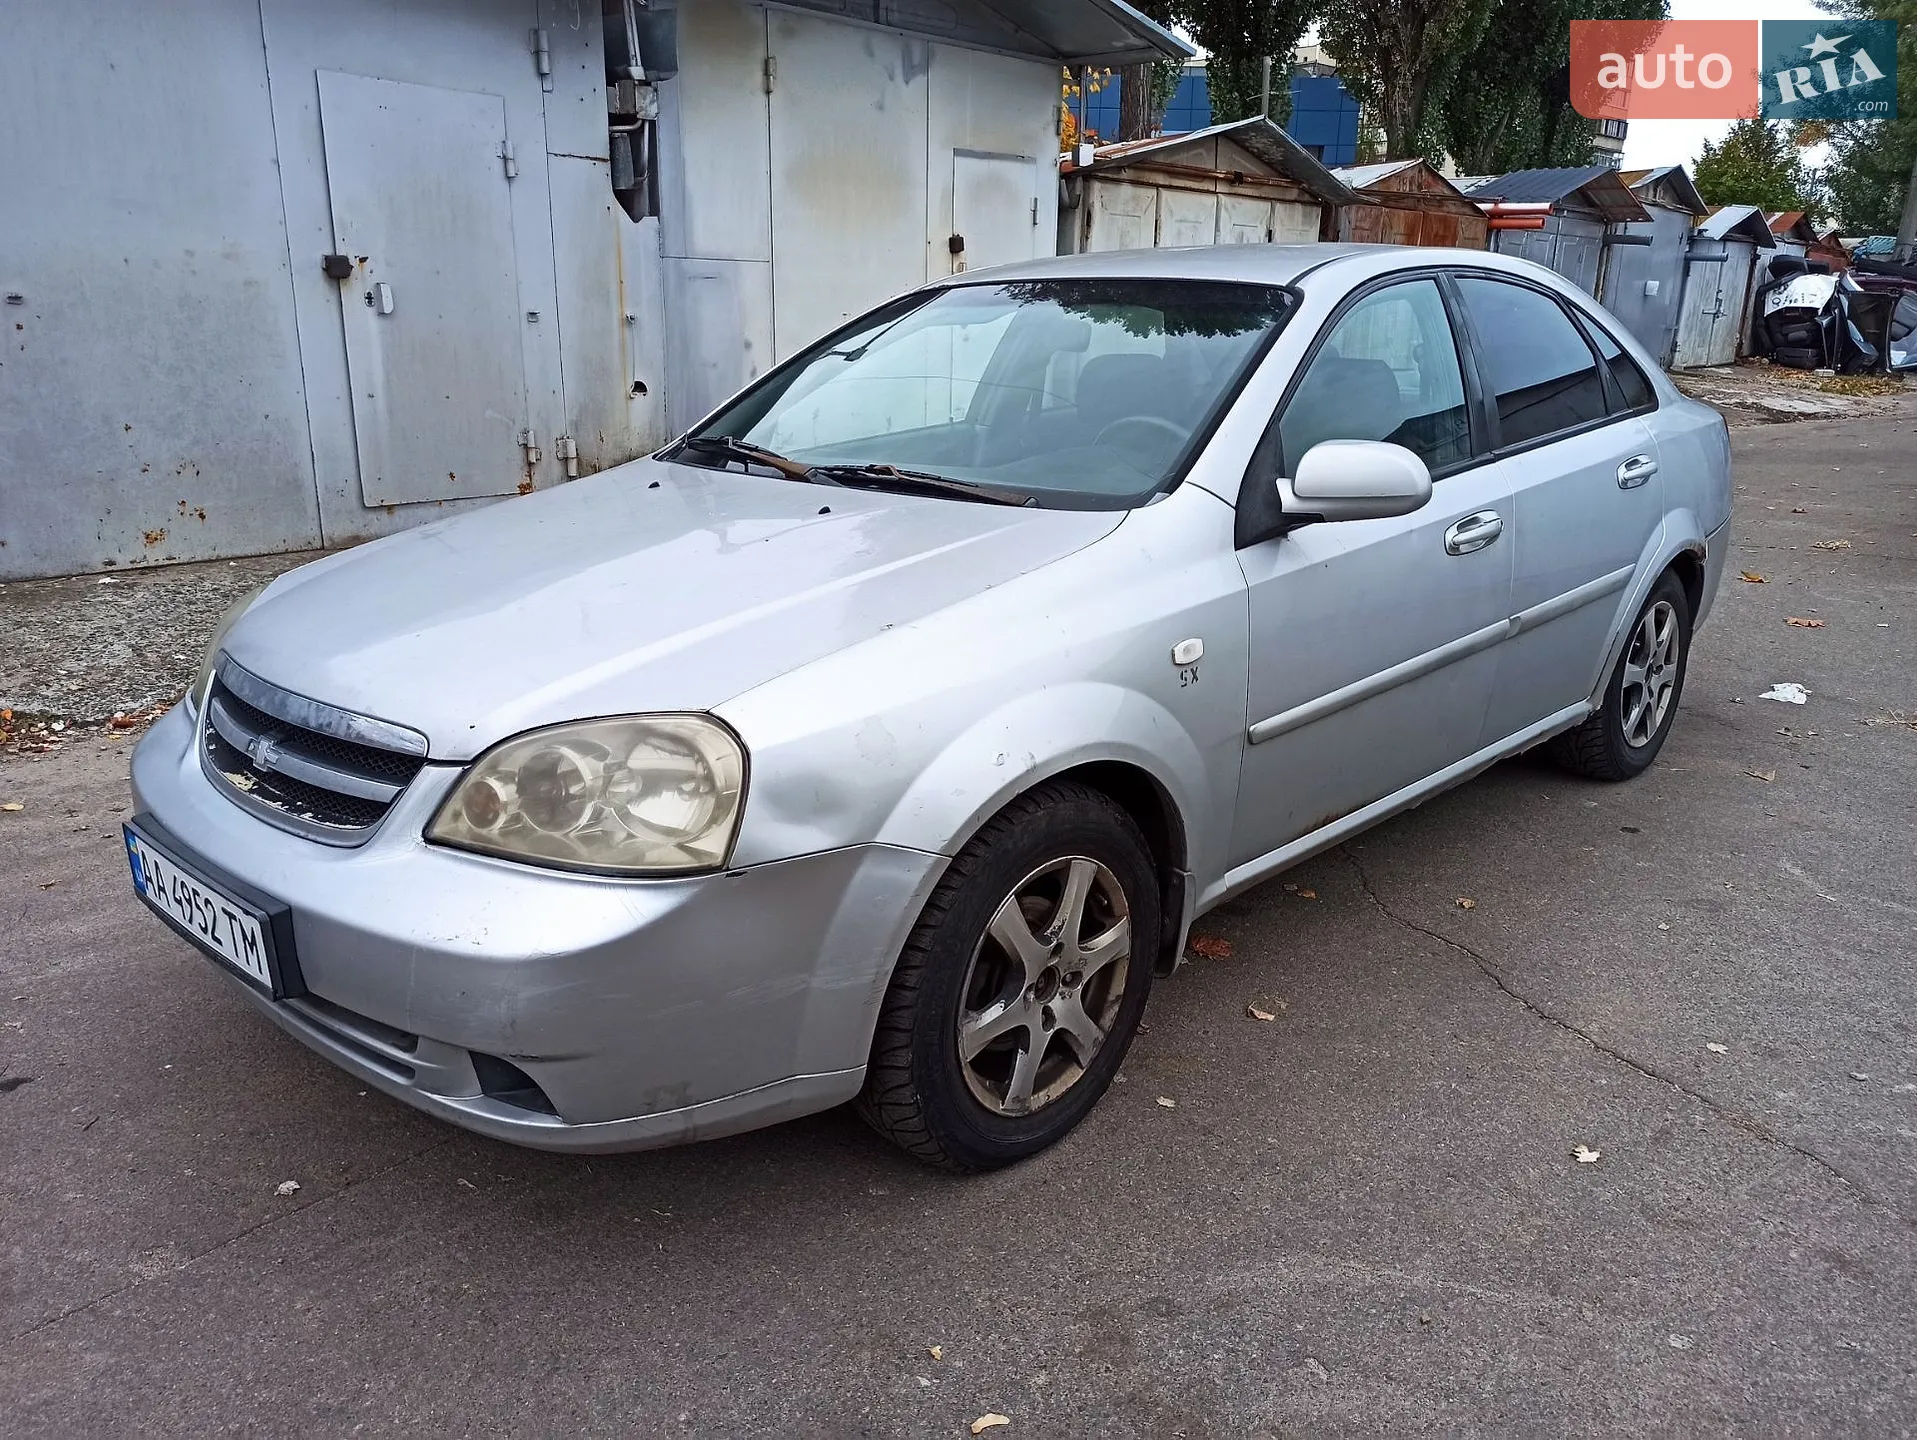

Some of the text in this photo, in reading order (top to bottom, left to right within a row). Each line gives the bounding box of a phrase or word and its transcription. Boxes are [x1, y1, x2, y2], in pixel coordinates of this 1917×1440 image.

[140, 849, 263, 975] AA 4952 TM
